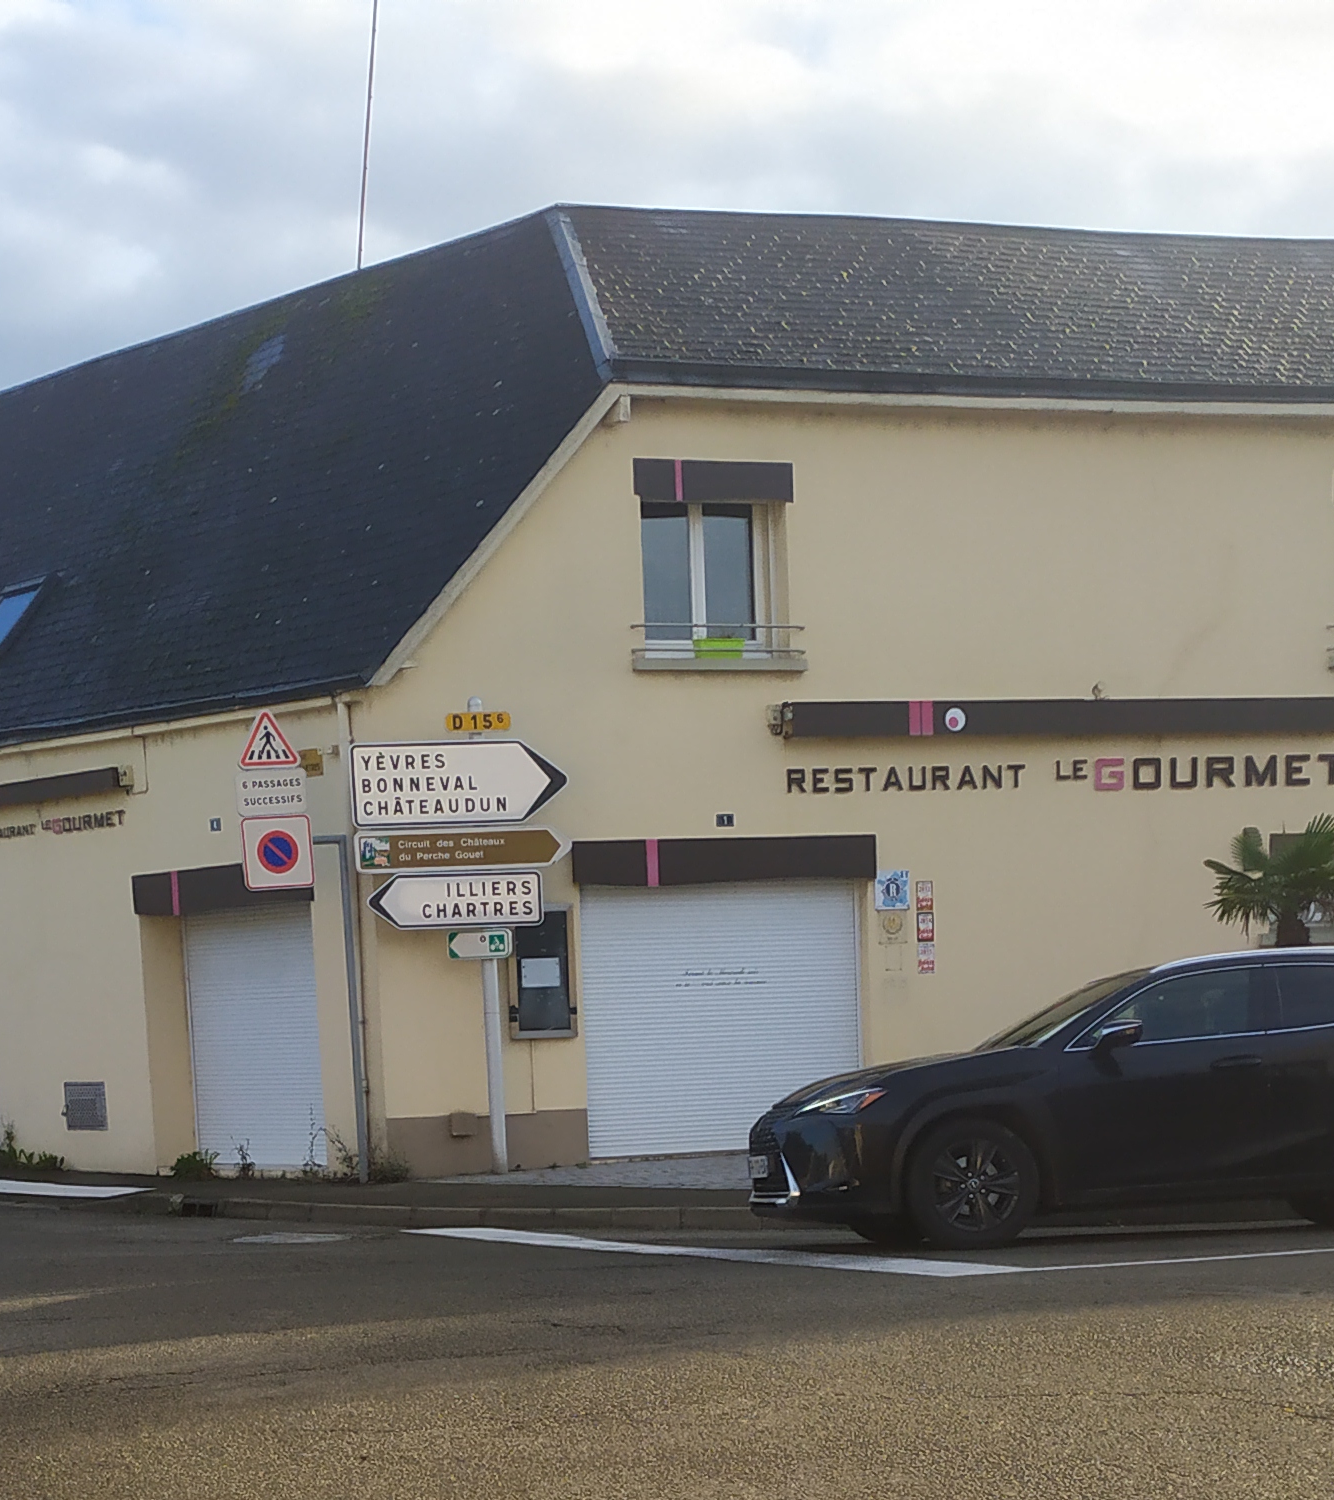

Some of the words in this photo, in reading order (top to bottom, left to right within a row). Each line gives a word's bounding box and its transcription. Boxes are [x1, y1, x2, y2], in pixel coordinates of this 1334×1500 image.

[452, 714, 463, 730] D
[361, 752, 446, 771] YÈVRES
[252, 778, 302, 789] PASSAGES
[362, 775, 478, 794] BONNEVAL
[786, 763, 1026, 793] RESTAURANT
[1055, 758, 1088, 781] LE
[244, 794, 303, 807] SUCCESSIFS
[363, 796, 507, 817] CHÂTEAUDUN
[52, 809, 126, 835] GOURMET
[398, 840, 430, 849] Circuit
[436, 839, 454, 848] des
[460, 838, 506, 847] Châteaux
[398, 853, 411, 861] du
[416, 851, 450, 860] Perche
[446, 880, 532, 898] ILLIERS
[422, 900, 533, 919] CHARTRES
